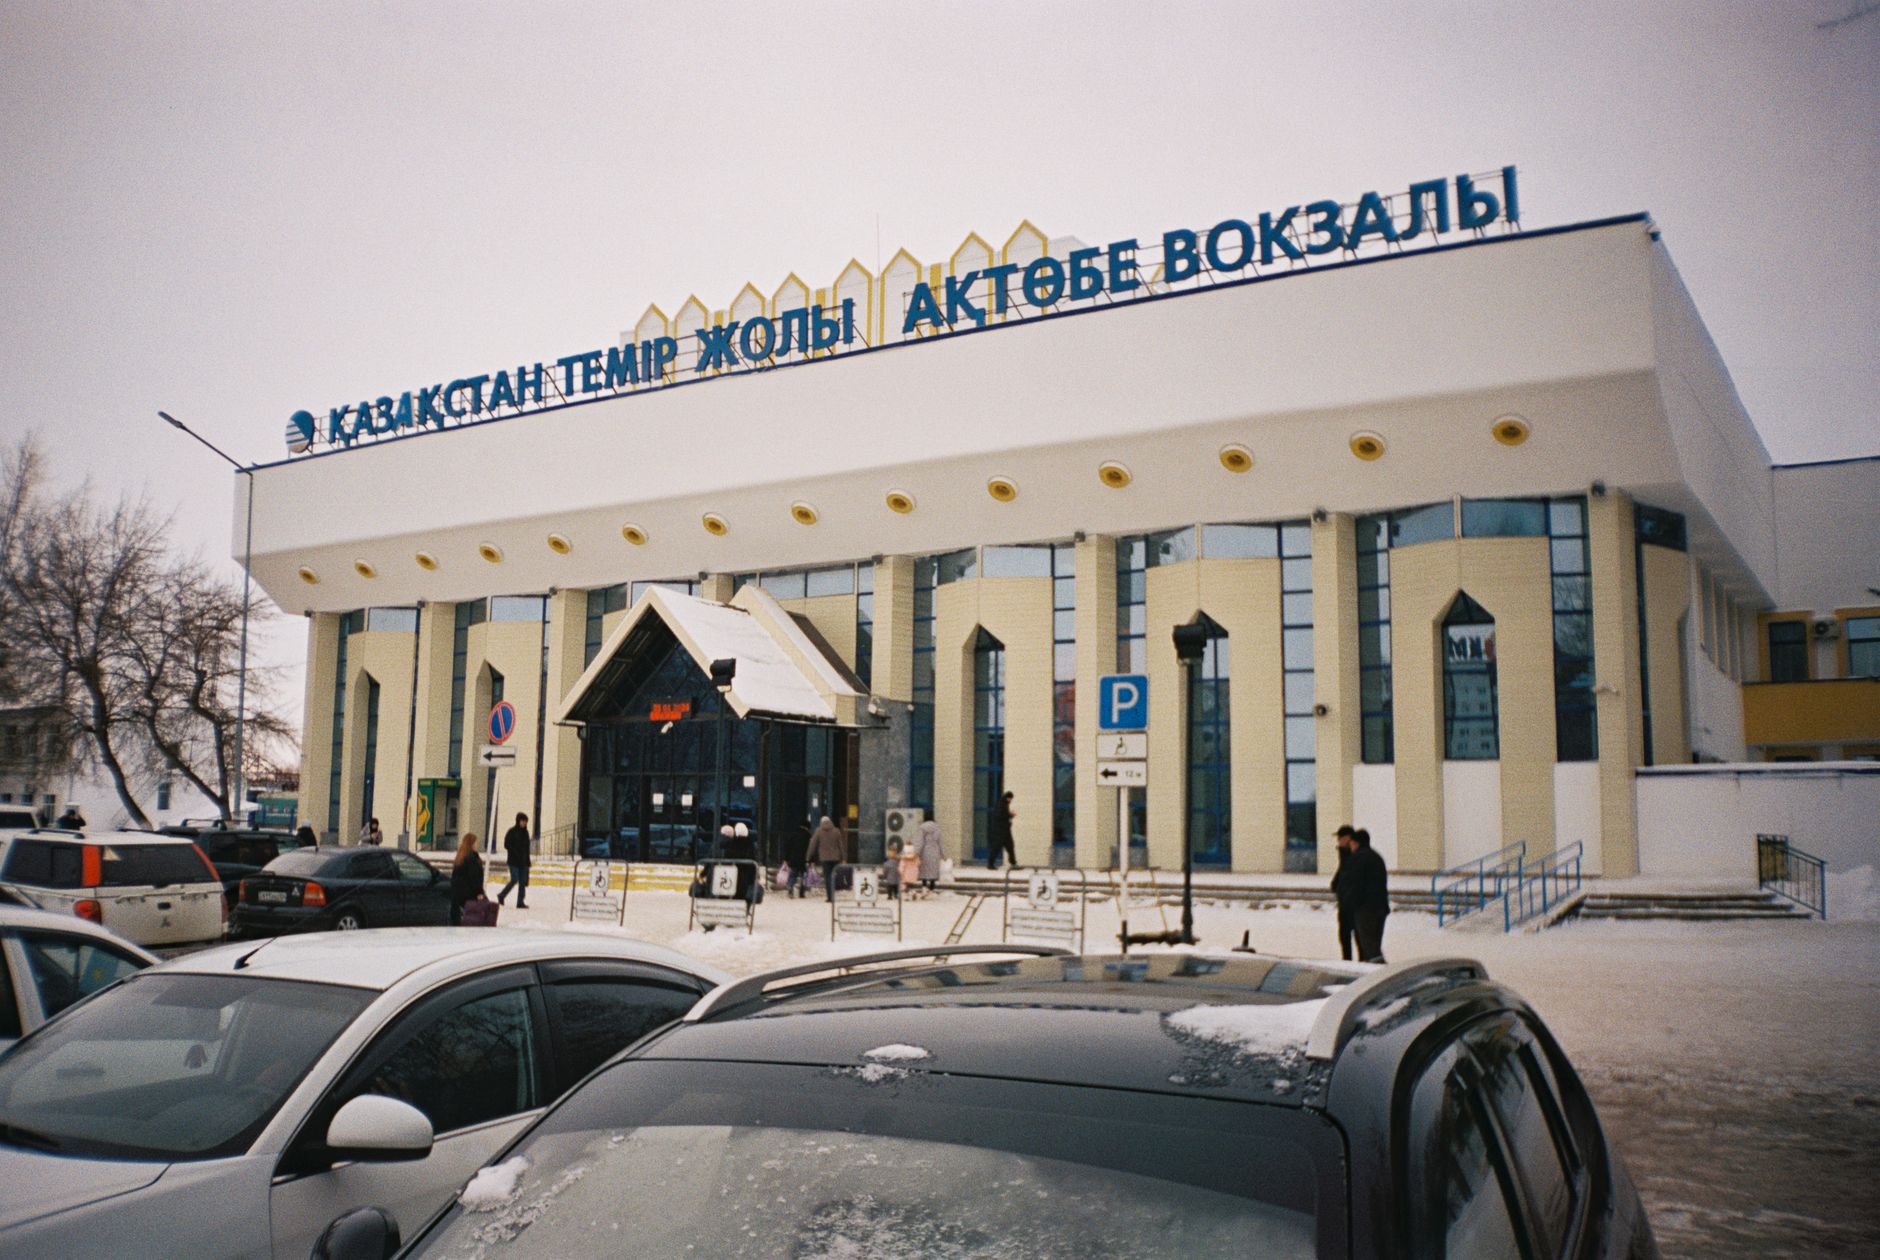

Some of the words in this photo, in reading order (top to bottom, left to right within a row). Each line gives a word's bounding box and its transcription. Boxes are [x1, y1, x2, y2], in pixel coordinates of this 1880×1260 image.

[329, 363, 543, 449] ҚАЗАҚСТАН
[557, 335, 678, 396] ТЕМІР
[695, 298, 854, 373] ЖОЛЫ
[902, 238, 1141, 333] АҚТӨБЕ
[1163, 165, 1520, 284] ВОКЗАЛЫ
[1111, 682, 1139, 723] P
